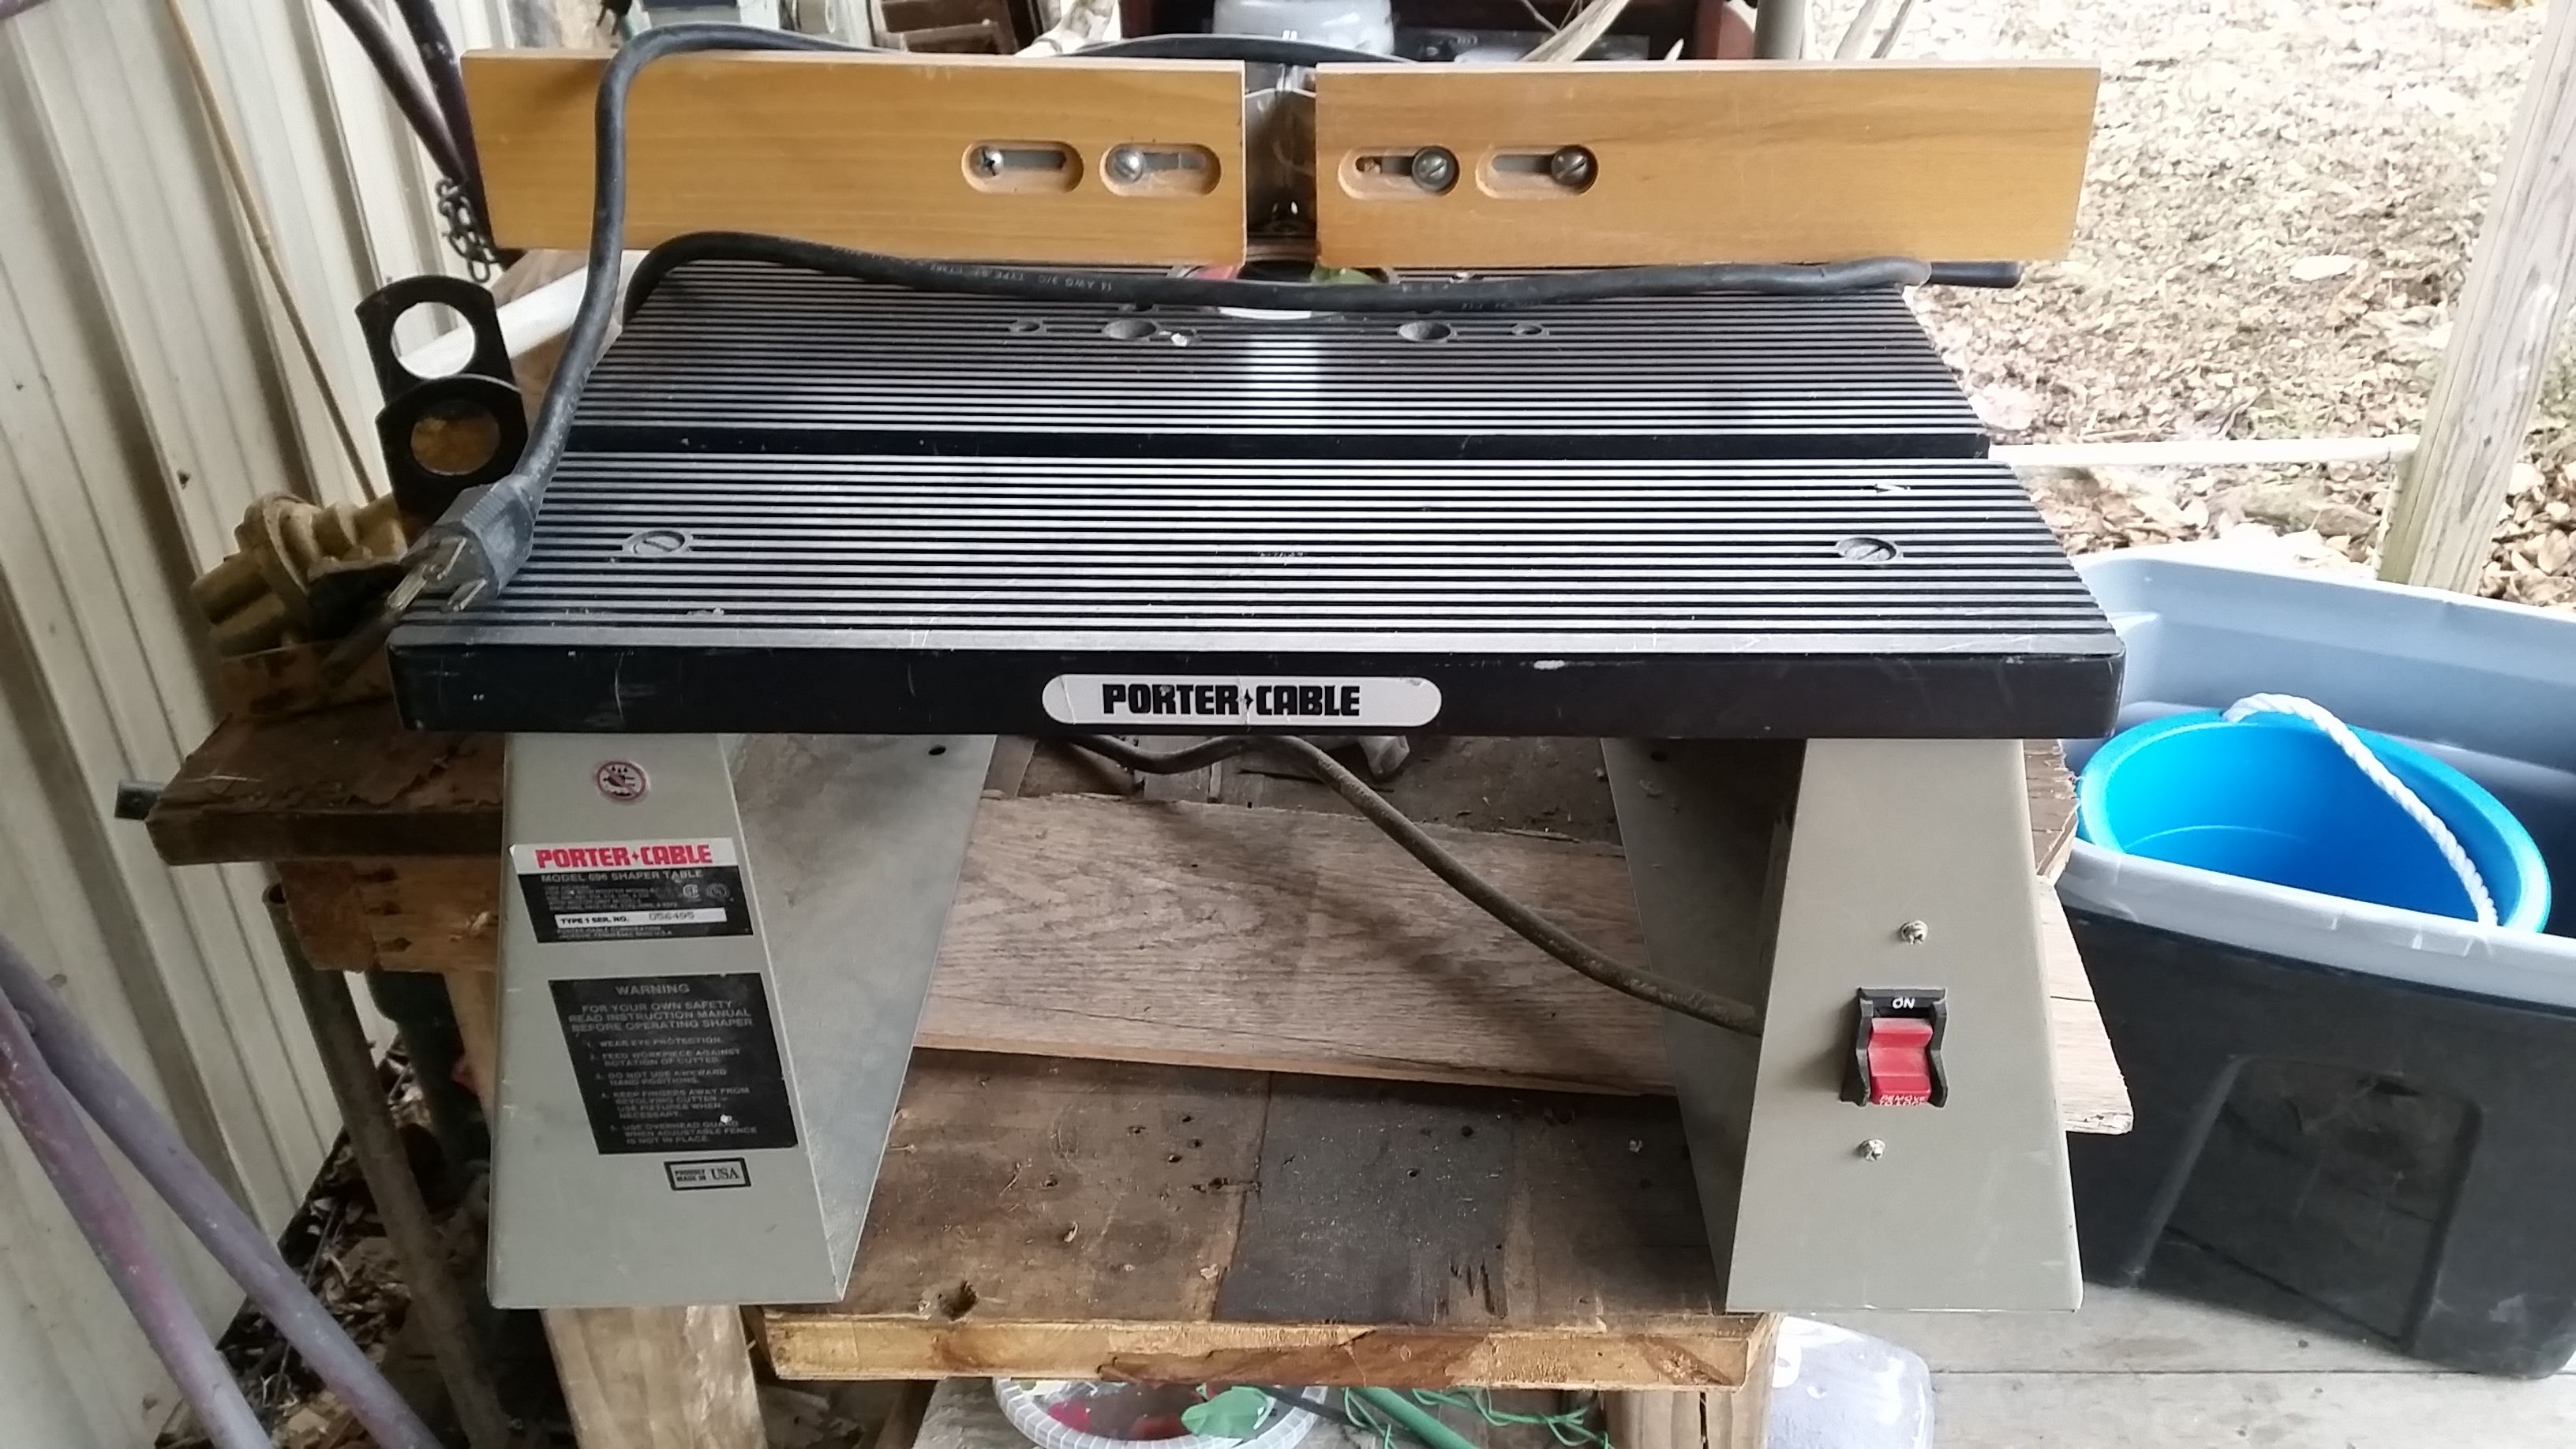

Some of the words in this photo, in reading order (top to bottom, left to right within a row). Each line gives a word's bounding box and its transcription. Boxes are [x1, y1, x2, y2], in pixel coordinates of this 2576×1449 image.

[1065, 277, 1095, 290] AWG
[1102, 683, 1240, 715] PORTER
[1256, 684, 1361, 717] CABLE
[534, 847, 631, 868] PORTER
[640, 844, 713, 866] CABLE
[541, 874, 586, 882] MODEL
[611, 871, 660, 881] SHAPER
[663, 869, 703, 879] TABLE
[616, 983, 690, 994] WARNING
[582, 1005, 607, 1013] FOR
[611, 1003, 647, 1012] YOUR
[651, 1002, 681, 1010] OWN
[685, 1000, 732, 1009] SAFETY
[1892, 997, 1916, 1009] ON
[568, 1013, 603, 1023] READ
[606, 1011, 694, 1022] INSTRUCTION
[697, 1009, 751, 1019] MANUAL
[571, 1022, 622, 1032] BEFORE
[625, 1019, 699, 1031] OPERATING
[702, 1017, 753, 1028] SHAPER
[710, 1167, 739, 1180] USA
